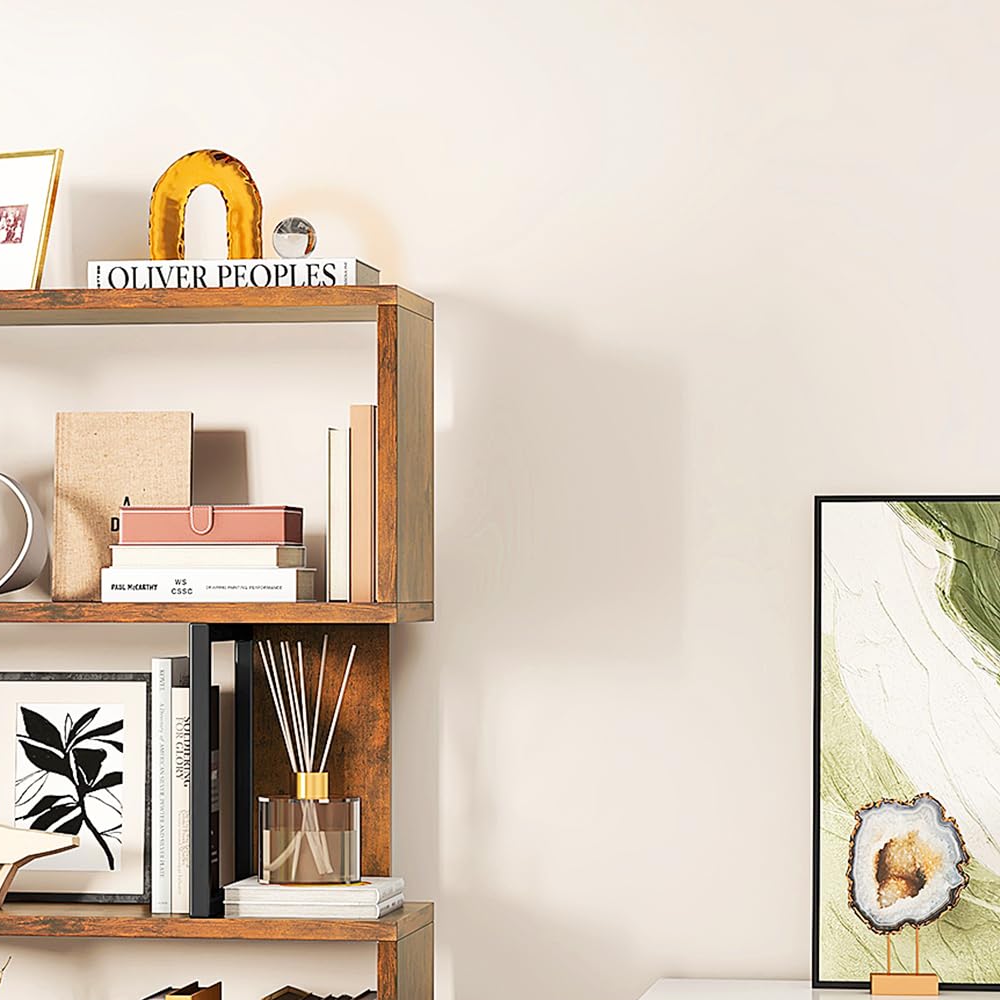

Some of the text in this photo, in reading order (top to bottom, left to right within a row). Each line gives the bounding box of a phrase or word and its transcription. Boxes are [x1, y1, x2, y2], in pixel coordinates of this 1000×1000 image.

[108, 264, 206, 288] OLIVER
[218, 262, 337, 288] PEOPLES
[174, 578, 187, 586] WS
[176, 717, 184, 778] FOR GLORY
